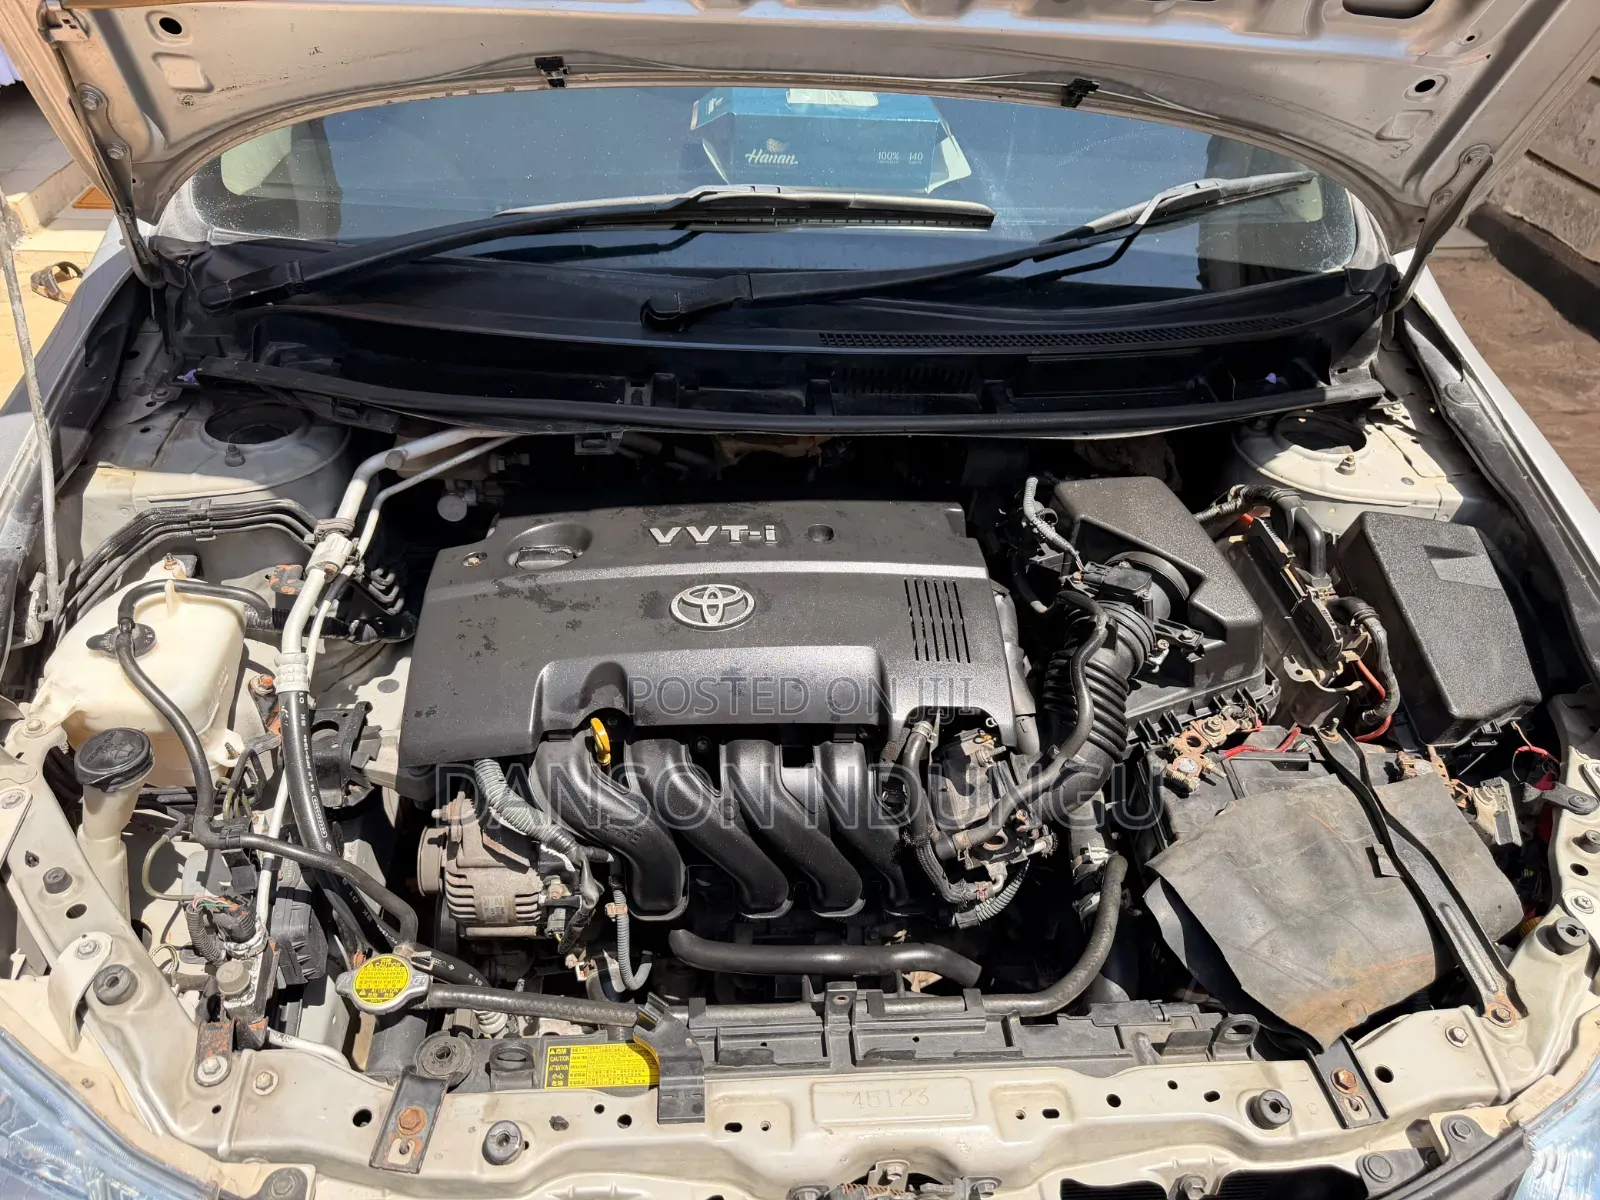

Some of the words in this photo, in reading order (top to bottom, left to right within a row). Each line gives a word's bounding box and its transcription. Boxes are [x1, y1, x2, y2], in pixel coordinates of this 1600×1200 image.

[744, 148, 799, 165] Hanan
[878, 151, 900, 161] 100%
[909, 151, 924, 161] 140
[649, 524, 778, 546] VVT-i
[851, 1087, 930, 1109] 45123
